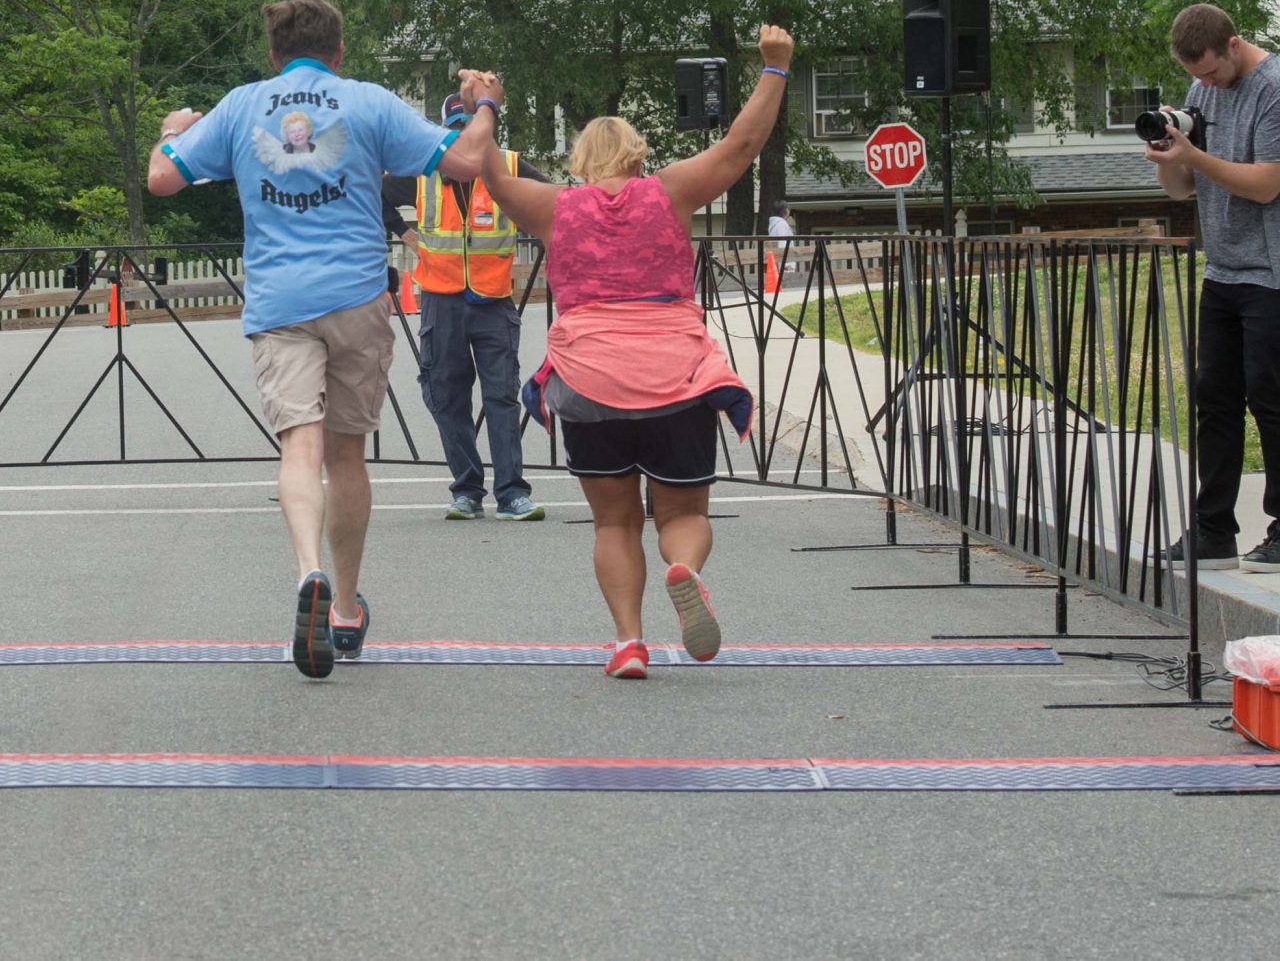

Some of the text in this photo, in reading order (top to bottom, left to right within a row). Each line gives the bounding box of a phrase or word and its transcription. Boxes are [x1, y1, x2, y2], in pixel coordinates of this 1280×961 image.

[265, 90, 340, 116] Jean's
[869, 141, 922, 171] STOP
[260, 175, 347, 214] Angels!
